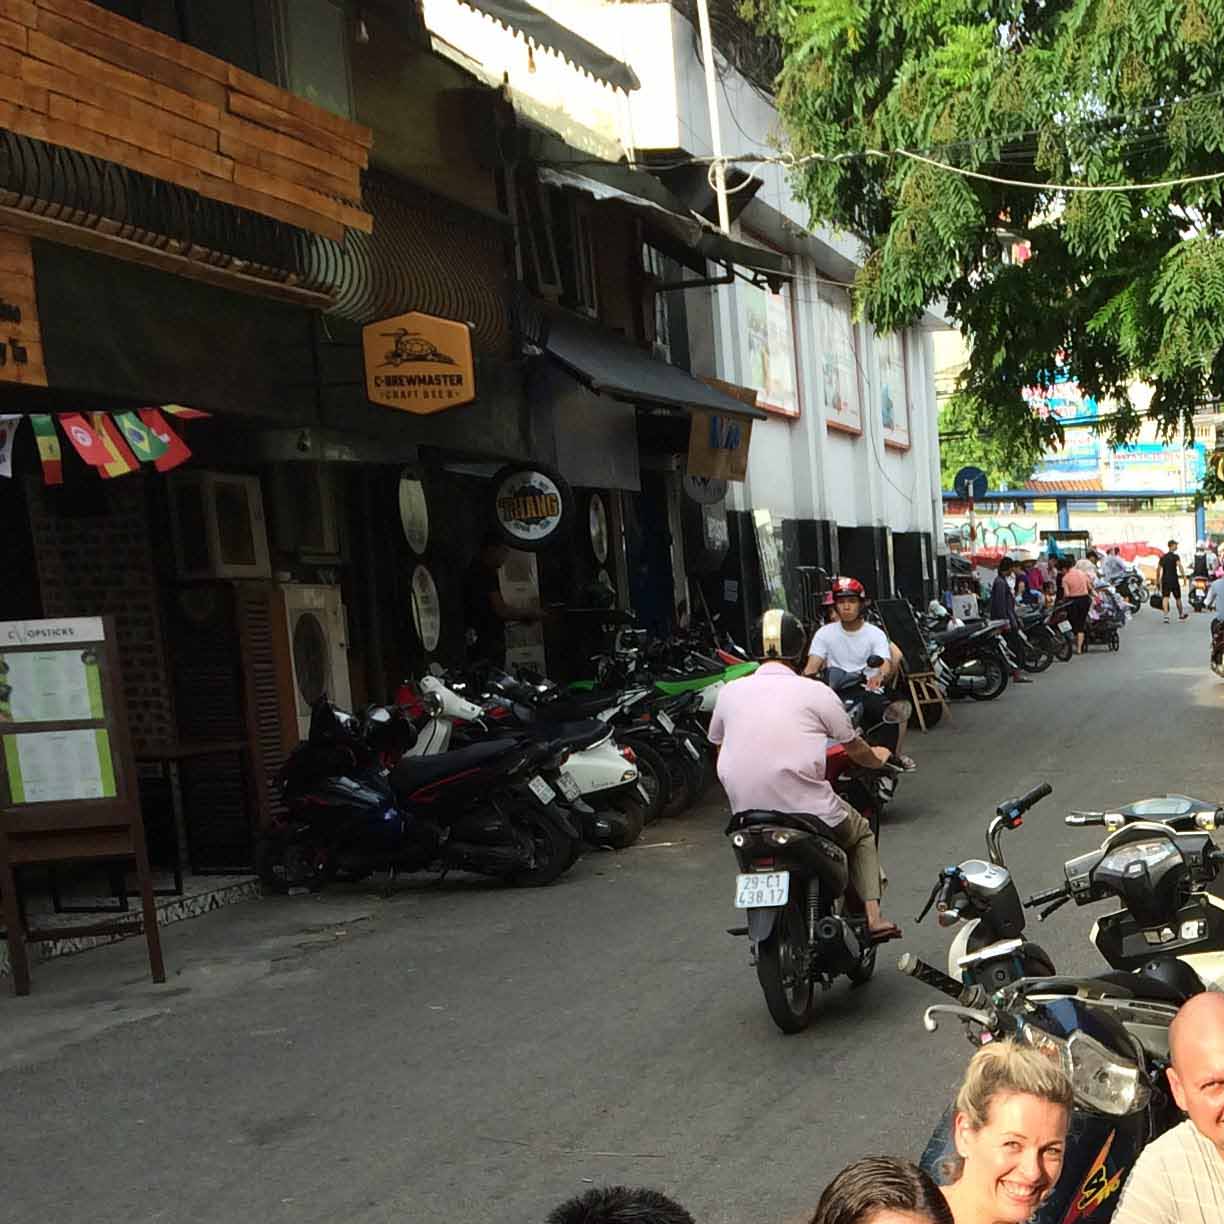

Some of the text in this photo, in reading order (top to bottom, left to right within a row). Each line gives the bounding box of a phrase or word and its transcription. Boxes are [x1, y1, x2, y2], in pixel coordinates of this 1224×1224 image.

[385, 390, 453, 400] CRAFT BEER
[744, 874, 780, 890] 29-C1
